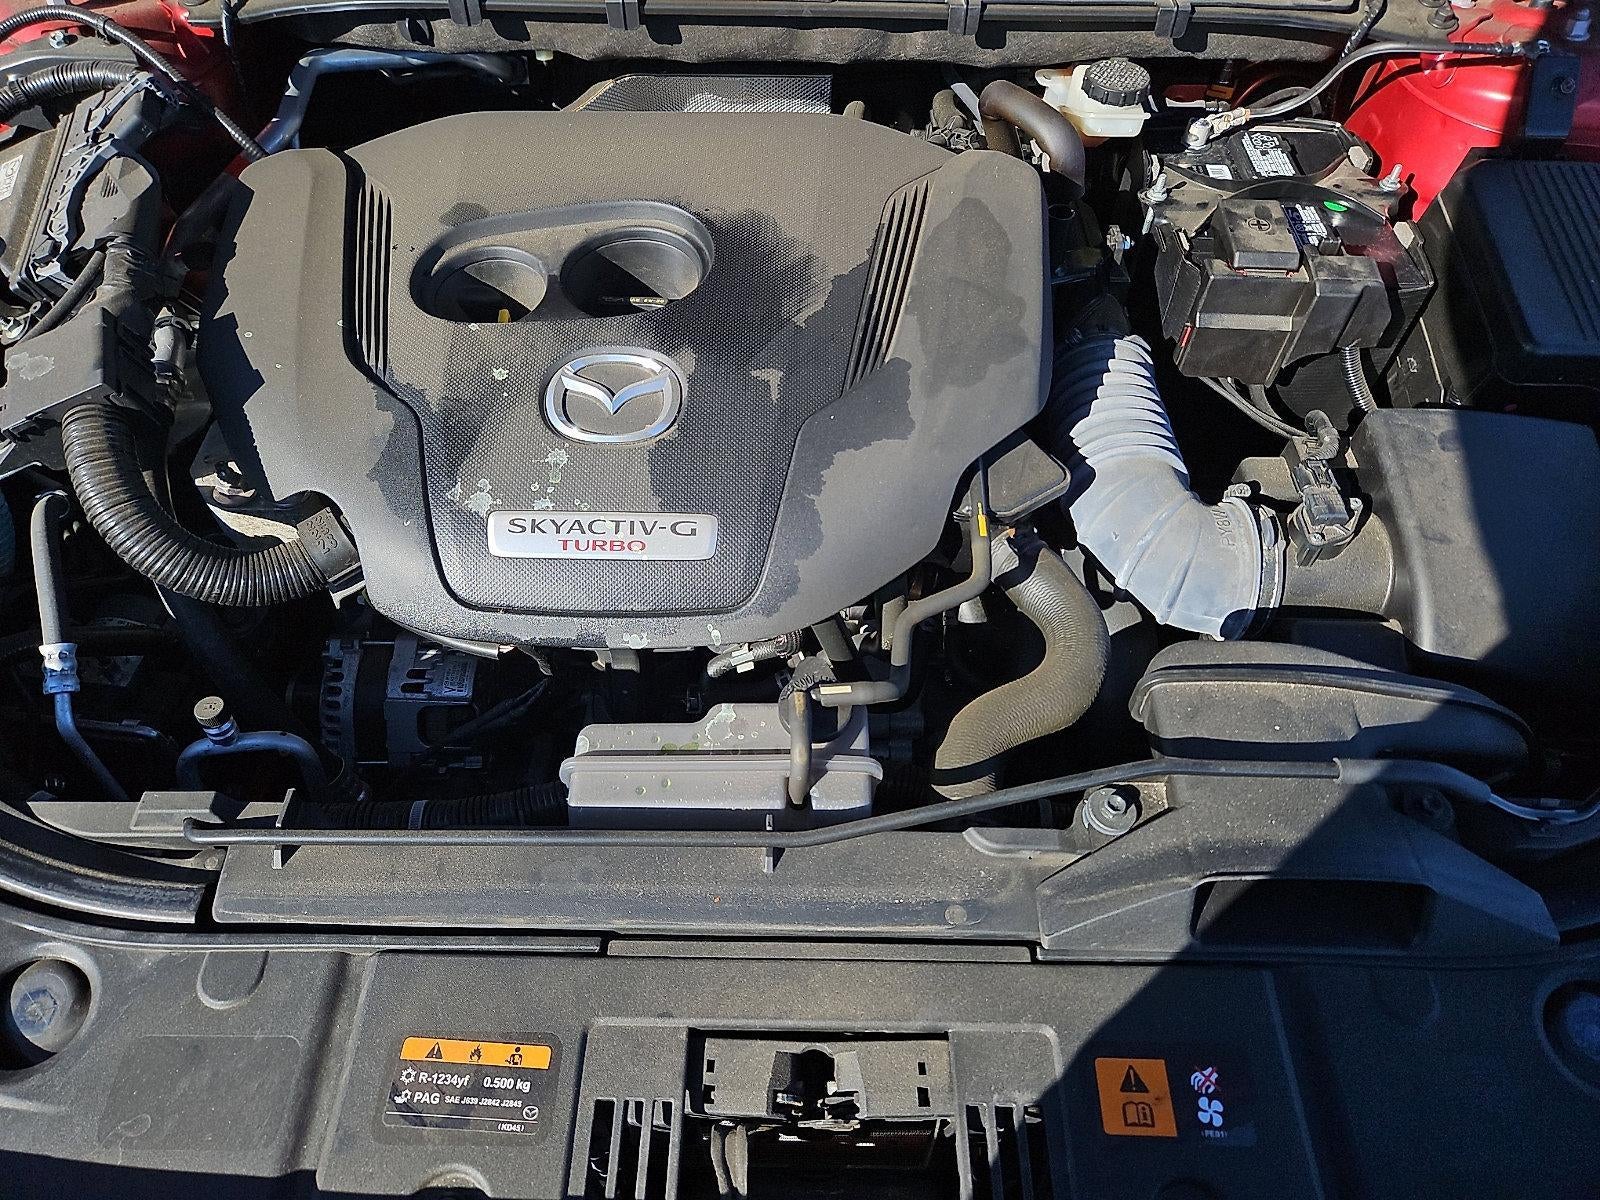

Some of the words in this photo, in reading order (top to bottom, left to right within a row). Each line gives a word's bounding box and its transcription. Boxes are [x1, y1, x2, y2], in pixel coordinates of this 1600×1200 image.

[507, 517, 698, 537] SKYACTIV-G
[558, 539, 646, 552] TURBO
[418, 1072, 470, 1089] R-1234yf
[483, 1076, 515, 1089] 0.500
[516, 1078, 531, 1093] kg
[413, 1091, 441, 1104] PAG
[444, 1095, 460, 1104] SAE
[461, 1096, 478, 1105] J639
